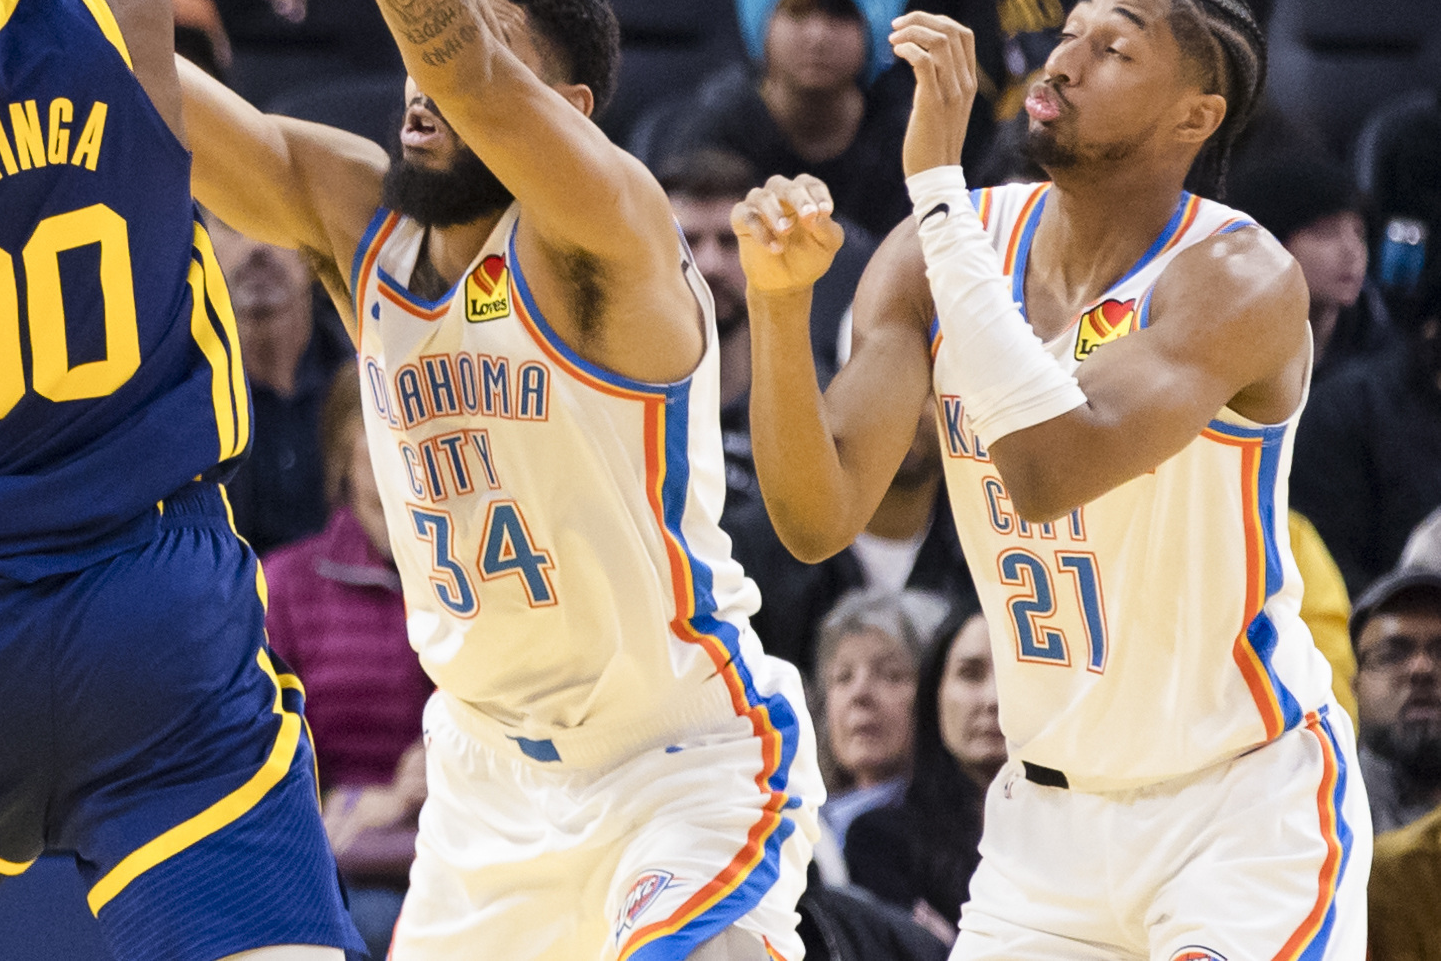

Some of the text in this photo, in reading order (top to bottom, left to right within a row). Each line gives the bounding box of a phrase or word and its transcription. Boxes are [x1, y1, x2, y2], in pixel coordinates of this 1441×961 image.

[365, 351, 551, 431] OLAHOMA
[399, 429, 501, 503] CITY
[405, 499, 558, 620] 34
[996, 546, 1110, 676] 21
